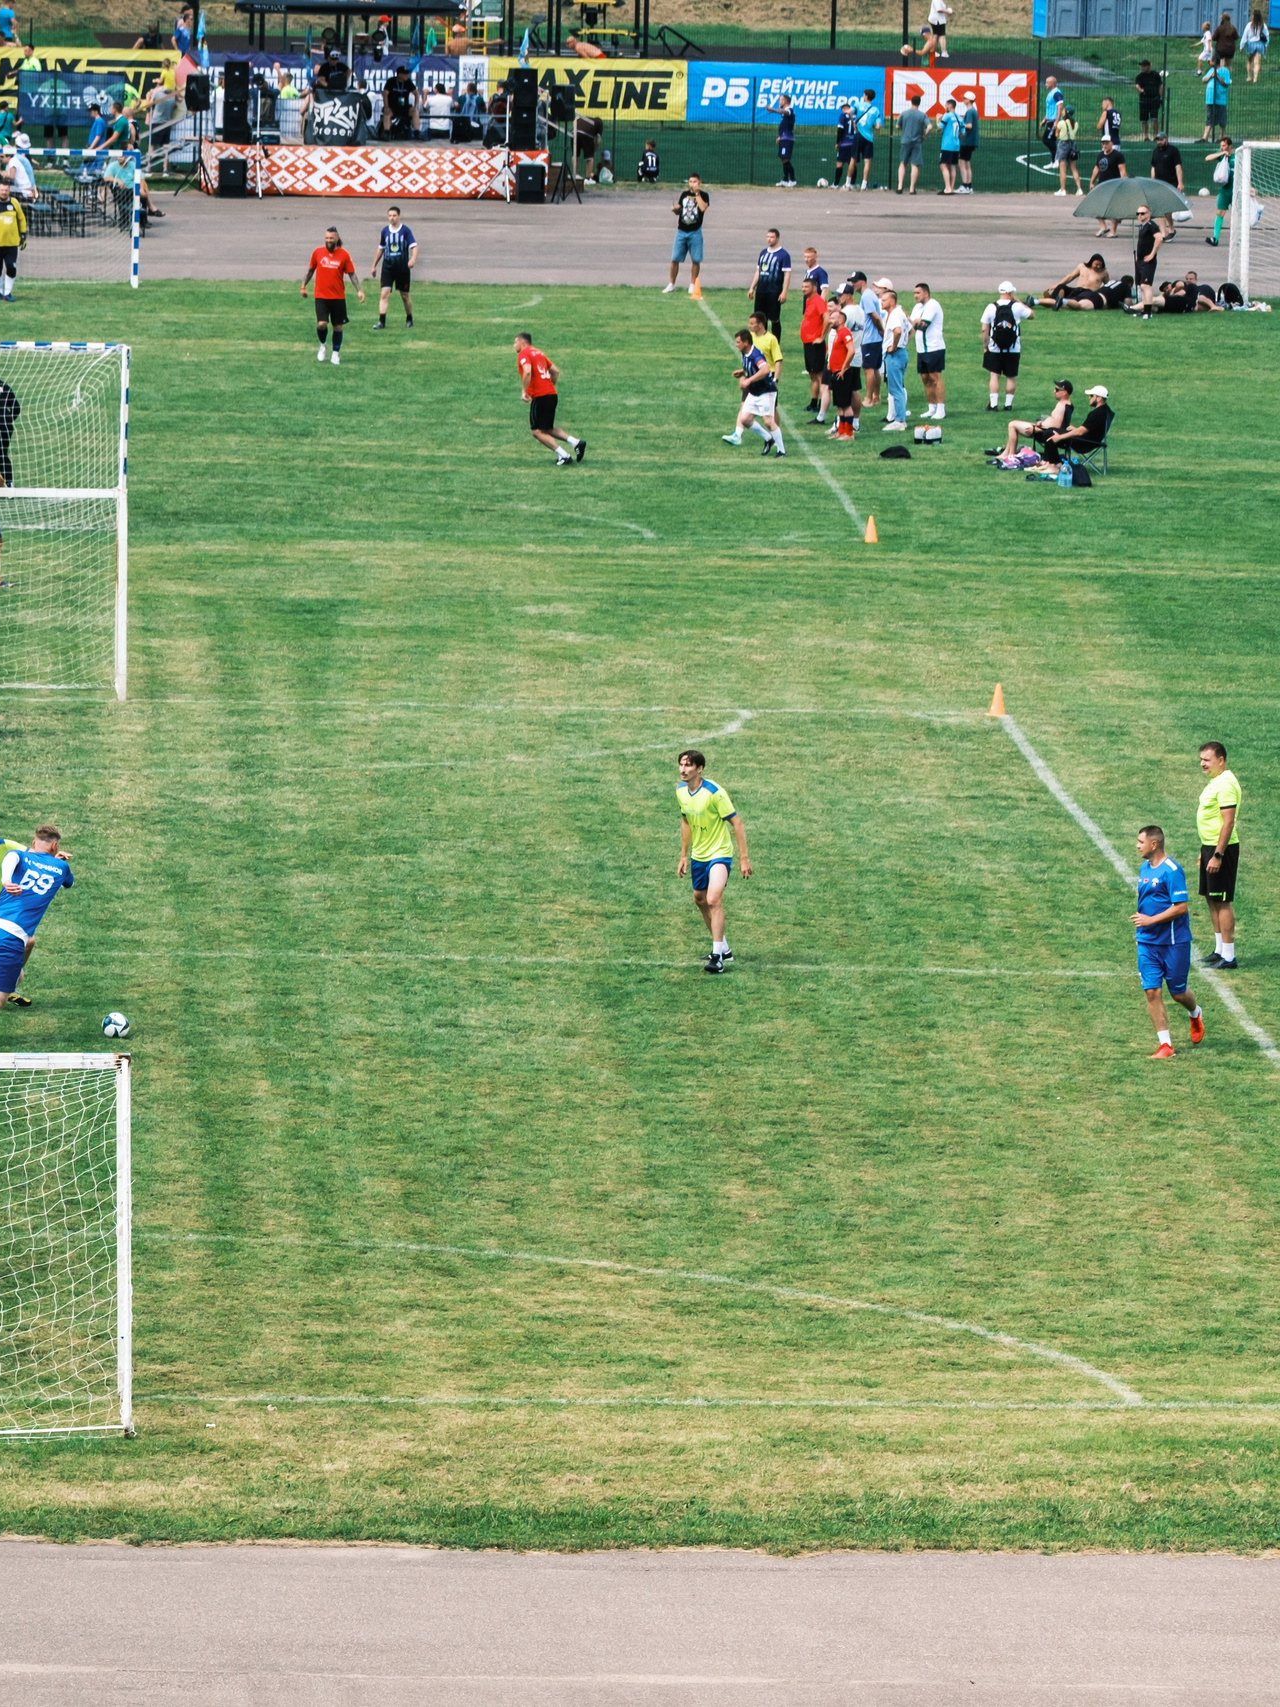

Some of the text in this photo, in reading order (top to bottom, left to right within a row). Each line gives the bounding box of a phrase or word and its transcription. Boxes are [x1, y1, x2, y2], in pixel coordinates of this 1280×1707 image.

[423, 70, 457, 93] CUP
[506, 69, 673, 110] AXLINE
[759, 76, 839, 95] РЕЙТИНГ
[700, 76, 751, 107] РБ
[756, 94, 865, 110] БУМЕКЕРО
[1112, 112, 1122, 126] 35
[647, 155, 657, 167] 11
